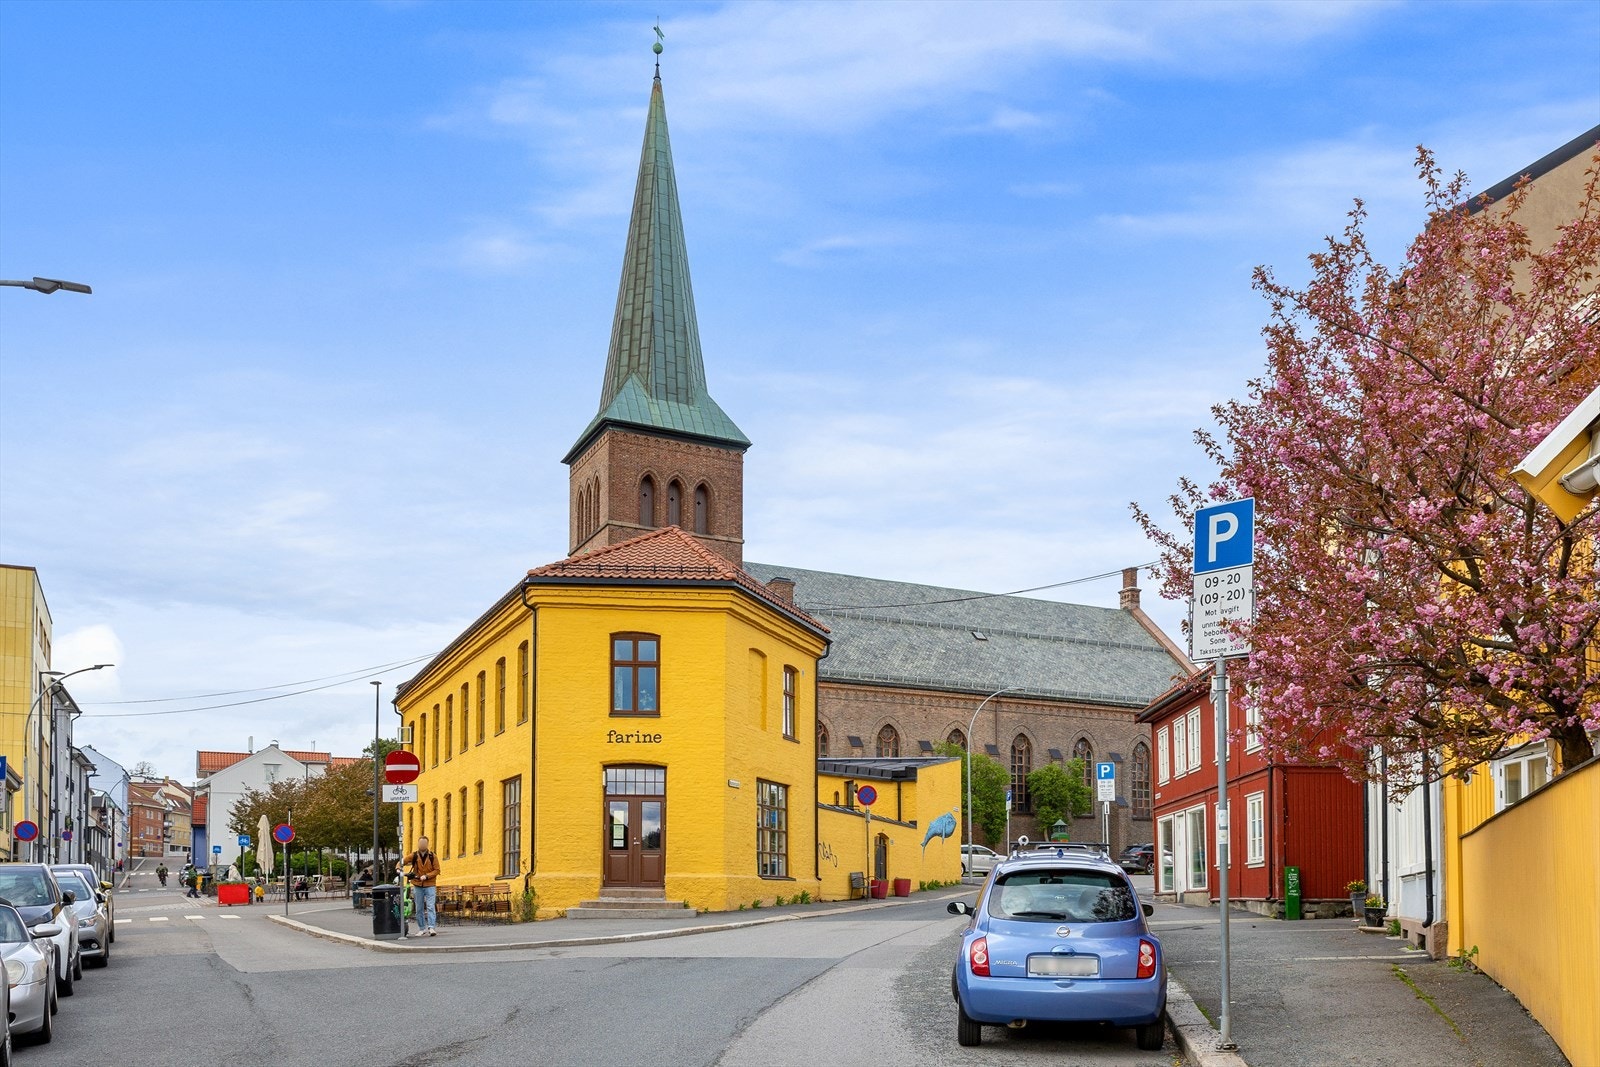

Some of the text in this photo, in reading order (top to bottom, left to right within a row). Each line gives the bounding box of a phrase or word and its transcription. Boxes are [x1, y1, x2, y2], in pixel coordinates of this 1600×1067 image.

[1208, 512, 1239, 563] P
[1204, 605, 1240, 617] Mot avgift
[1201, 621, 1222, 629] unnta
[1209, 637, 1227, 646] Sone
[1199, 647, 1228, 656] Takstsone
[606, 729, 662, 744] farine
[1100, 764, 1111, 778] P
